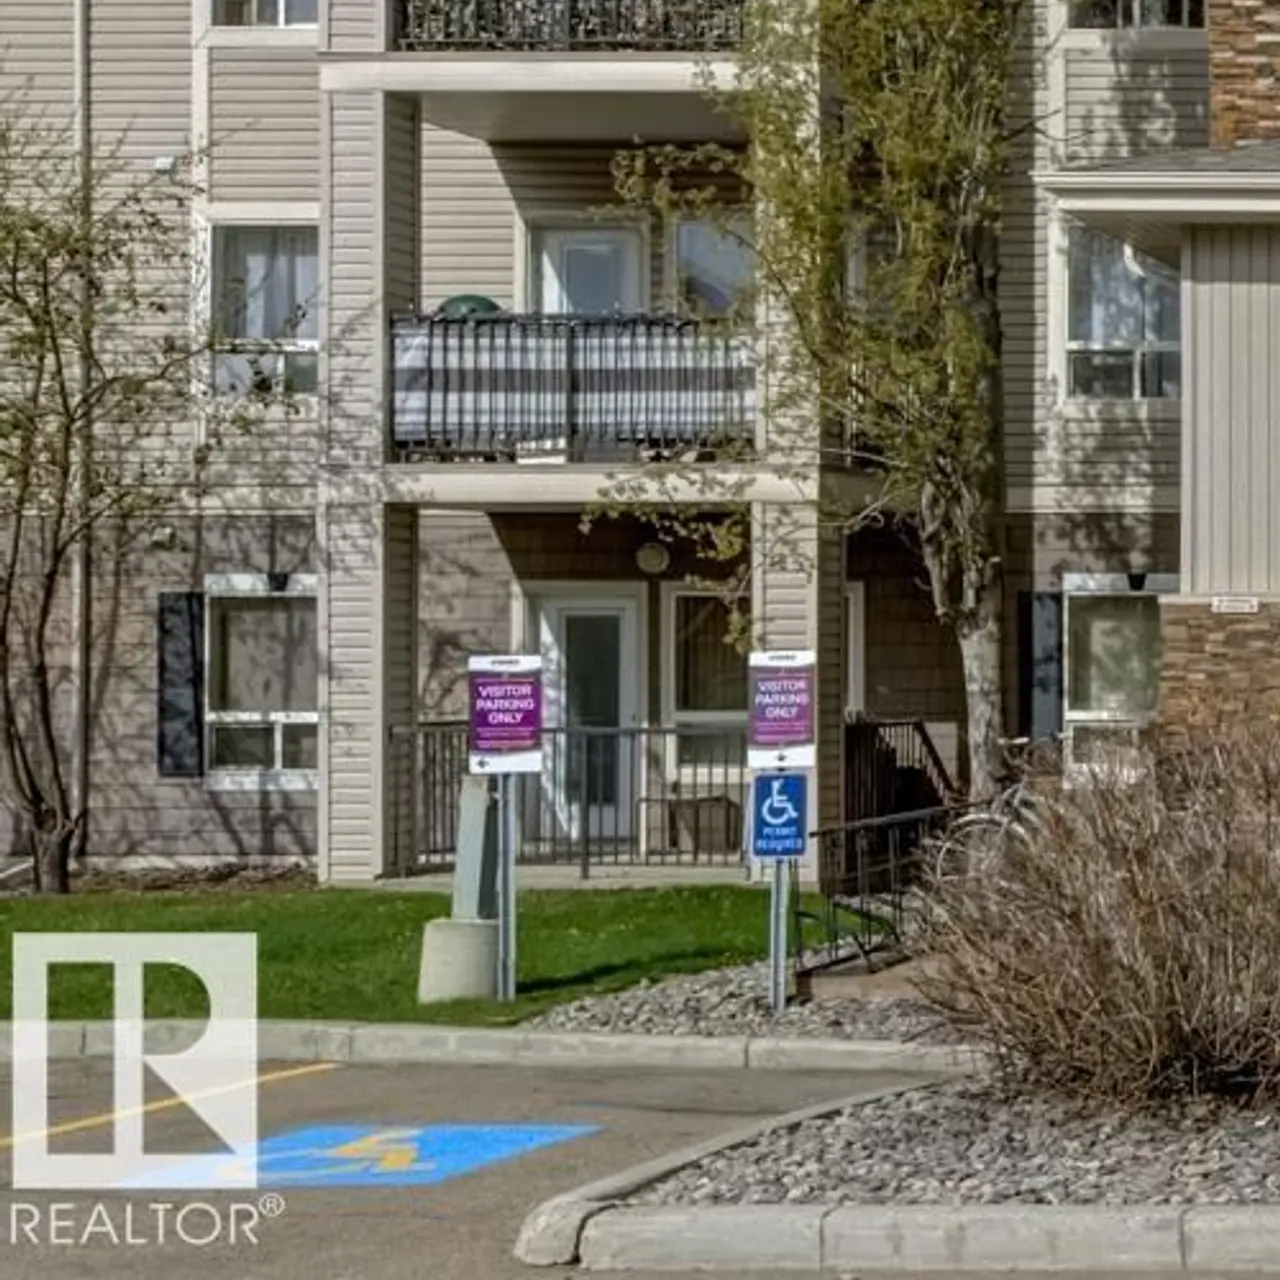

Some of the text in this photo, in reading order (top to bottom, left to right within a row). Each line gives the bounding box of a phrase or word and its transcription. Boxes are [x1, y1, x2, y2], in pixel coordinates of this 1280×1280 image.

[478, 684, 533, 698] VISITOR
[757, 680, 807, 693] VISITOR
[475, 699, 535, 711] PARKING
[755, 694, 810, 707] PARKING
[488, 712, 524, 724] ONLY
[765, 706, 799, 719] ONLY
